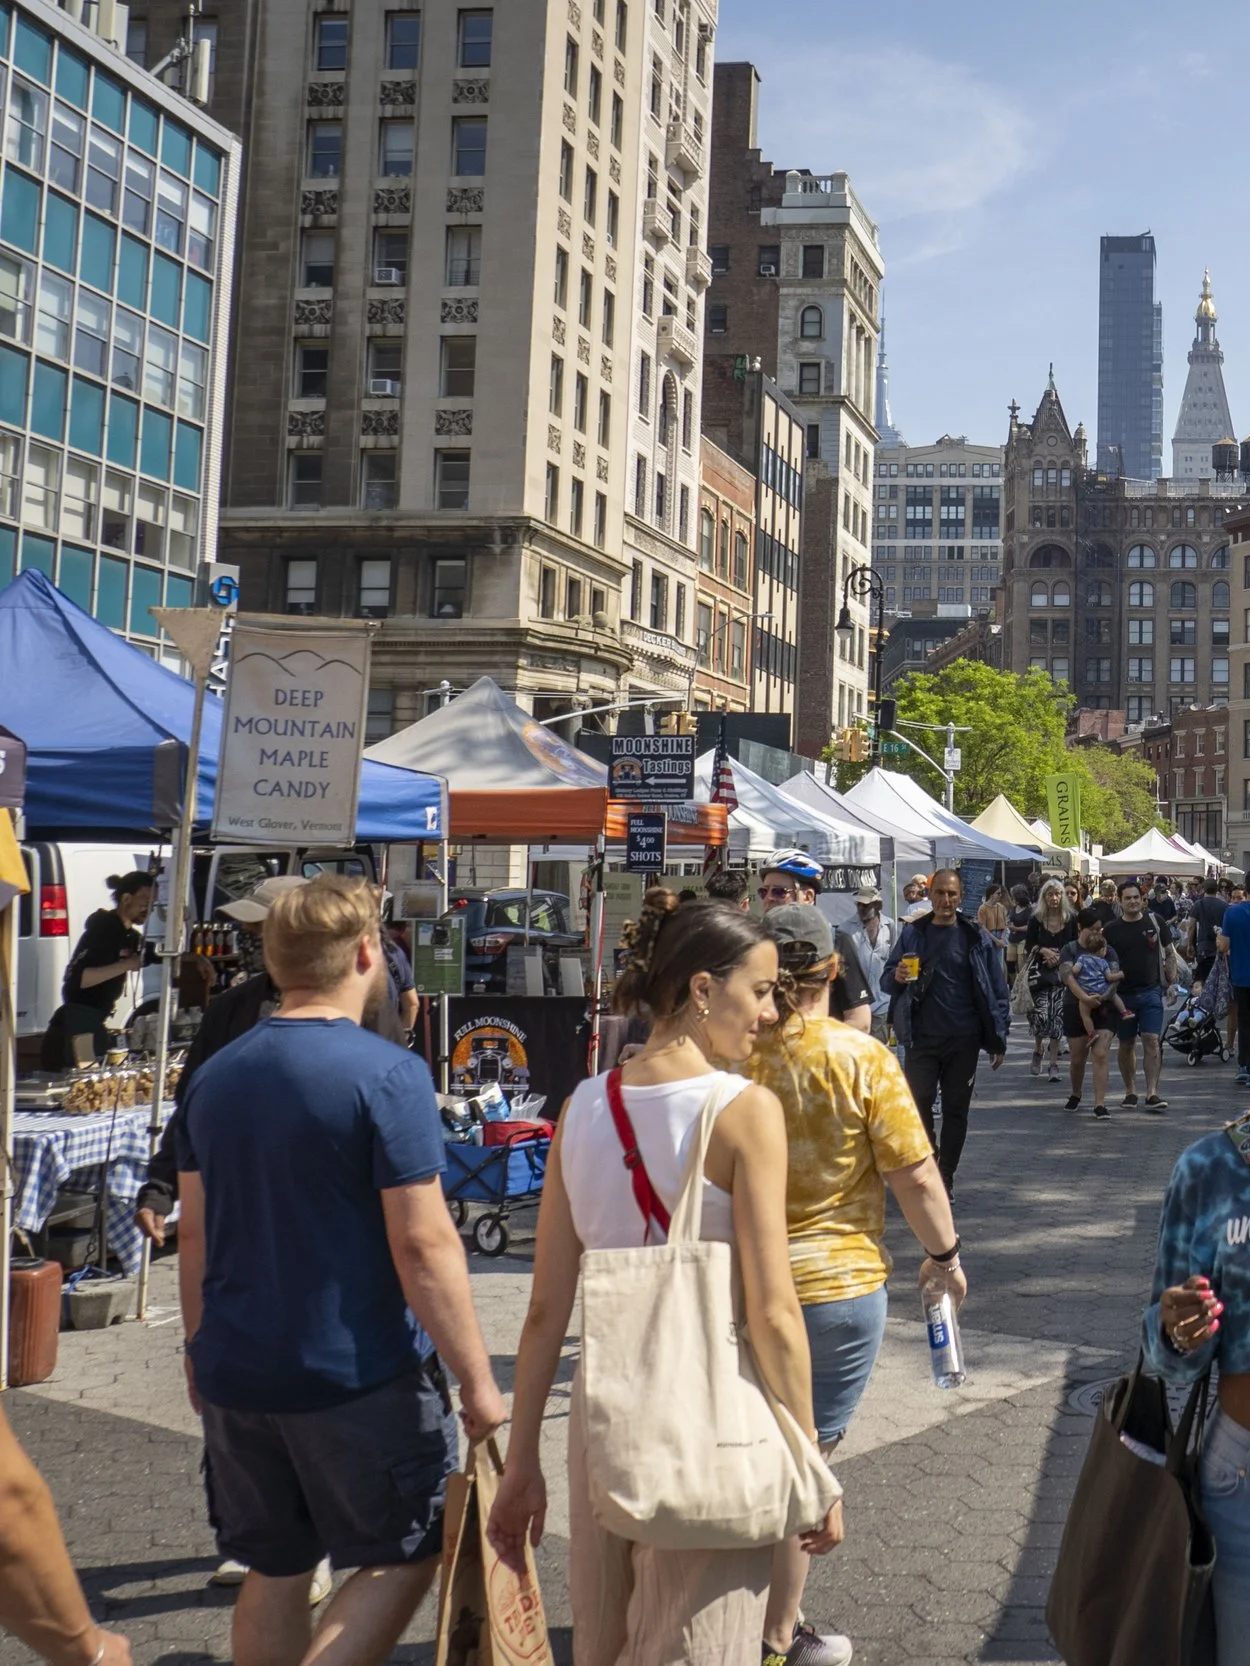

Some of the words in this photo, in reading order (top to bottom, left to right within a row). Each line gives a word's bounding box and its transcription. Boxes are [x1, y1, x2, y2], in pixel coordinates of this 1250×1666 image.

[274, 689, 325, 707] DEEP
[233, 717, 356, 740] MOUNTAIN
[613, 737, 693, 755] MOONSHINE
[883, 743, 888, 753] E
[890, 743, 899, 753] 16
[259, 749, 330, 768] MAPLE
[643, 758, 692, 775] Tastings
[253, 779, 331, 800] CANDY
[1055, 781, 1071, 845] GRAINS
[228, 816, 256, 828] West
[258, 816, 298, 831] Glover,
[300, 819, 343, 831] Vermont
[630, 851, 662, 862] SHOTS
[454, 1021, 475, 1042] FULL
[475, 1016, 528, 1043] MOONSHINE
